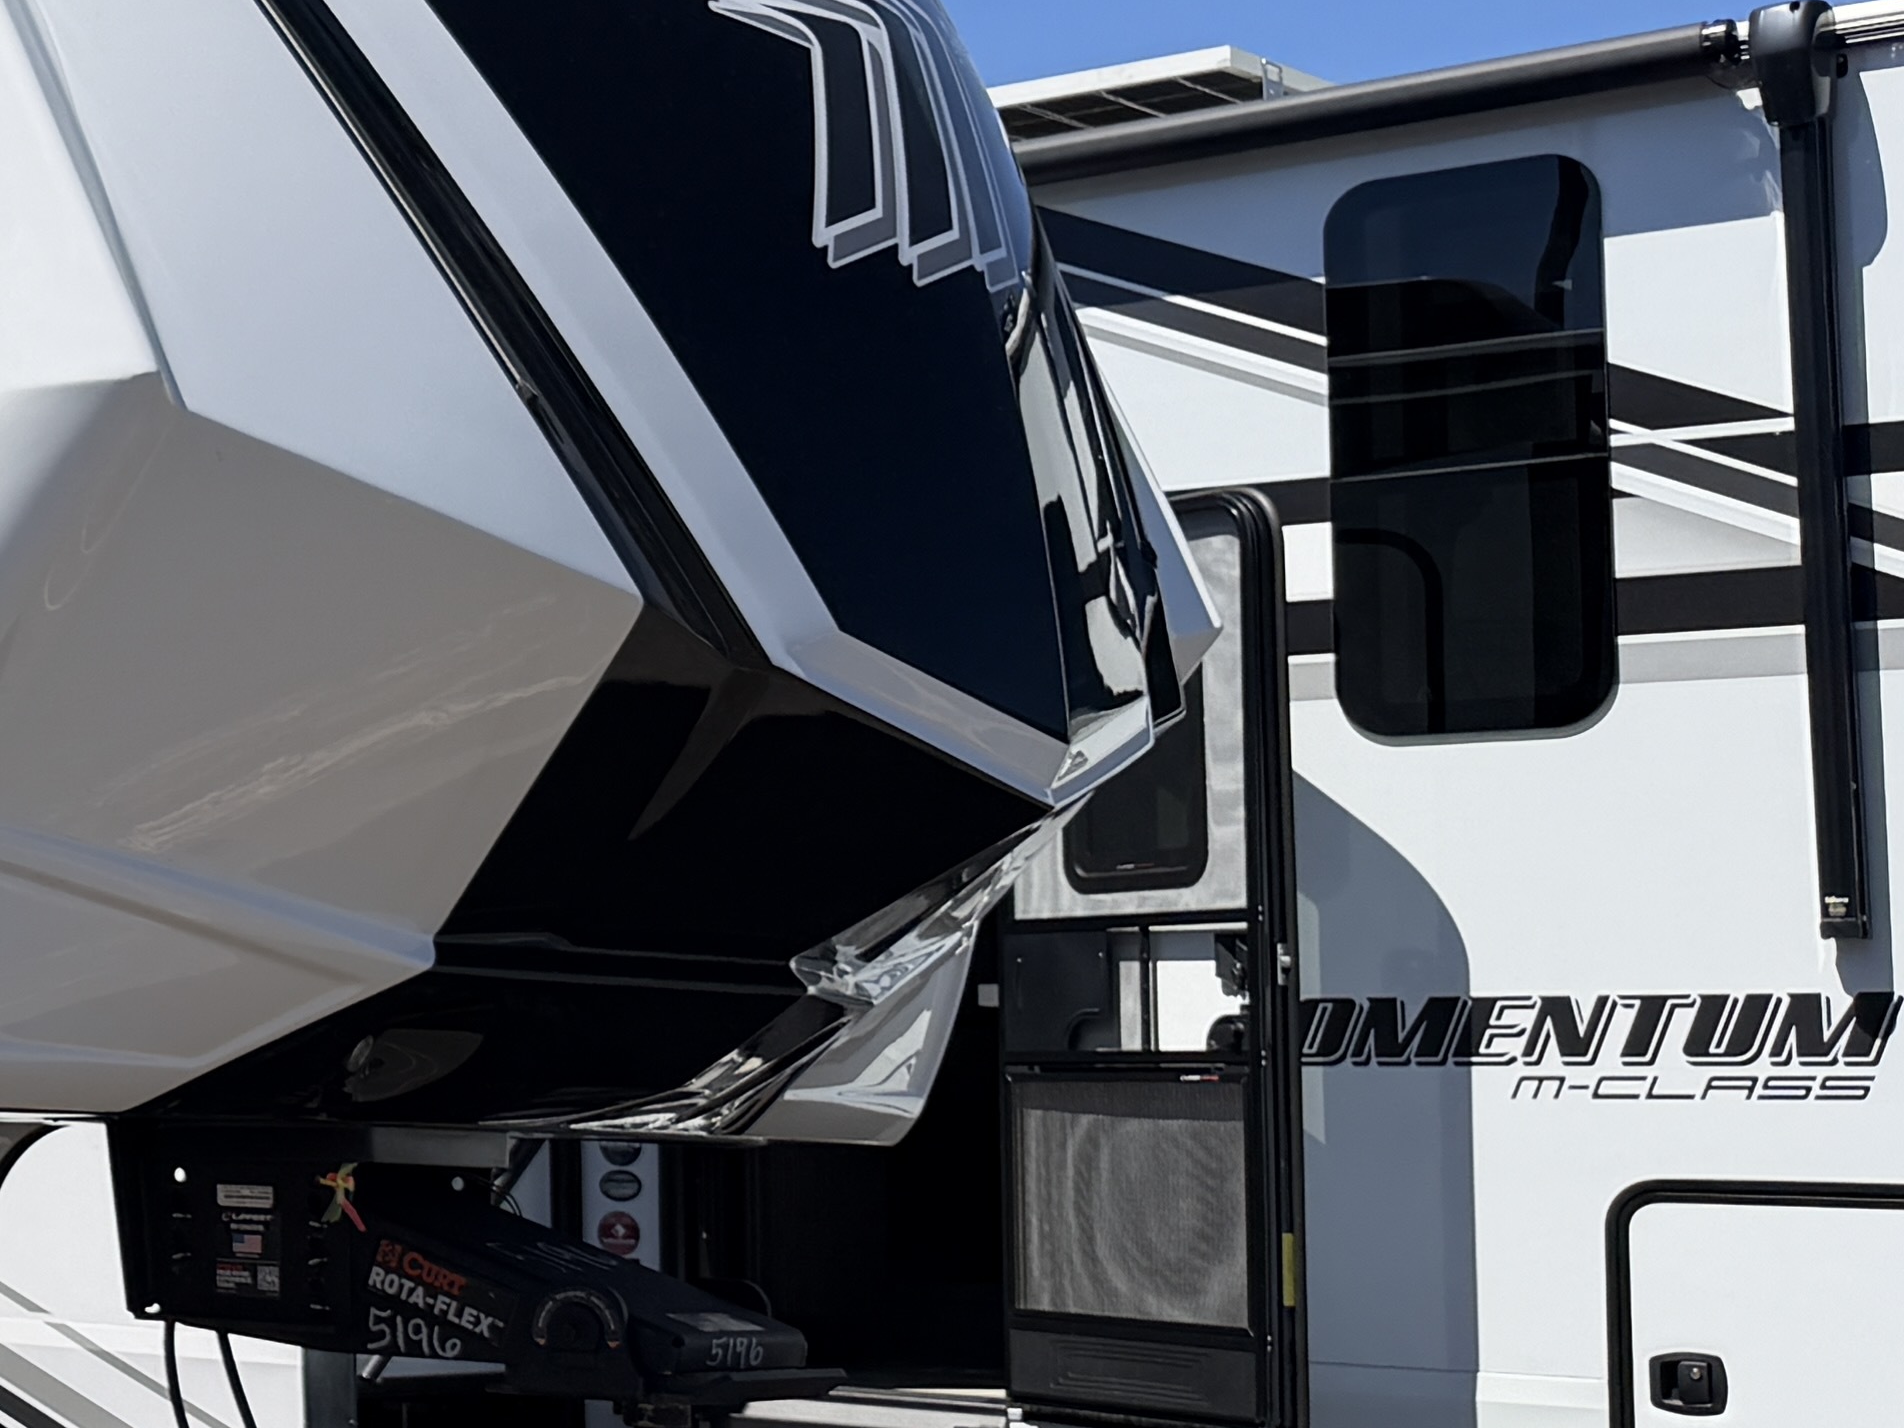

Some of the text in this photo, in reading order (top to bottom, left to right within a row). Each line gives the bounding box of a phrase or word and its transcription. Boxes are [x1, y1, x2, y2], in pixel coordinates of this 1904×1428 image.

[1299, 992, 1903, 1067] OMENTUM
[366, 1306, 462, 1358] 5196
[705, 1336, 765, 1369] 5196
